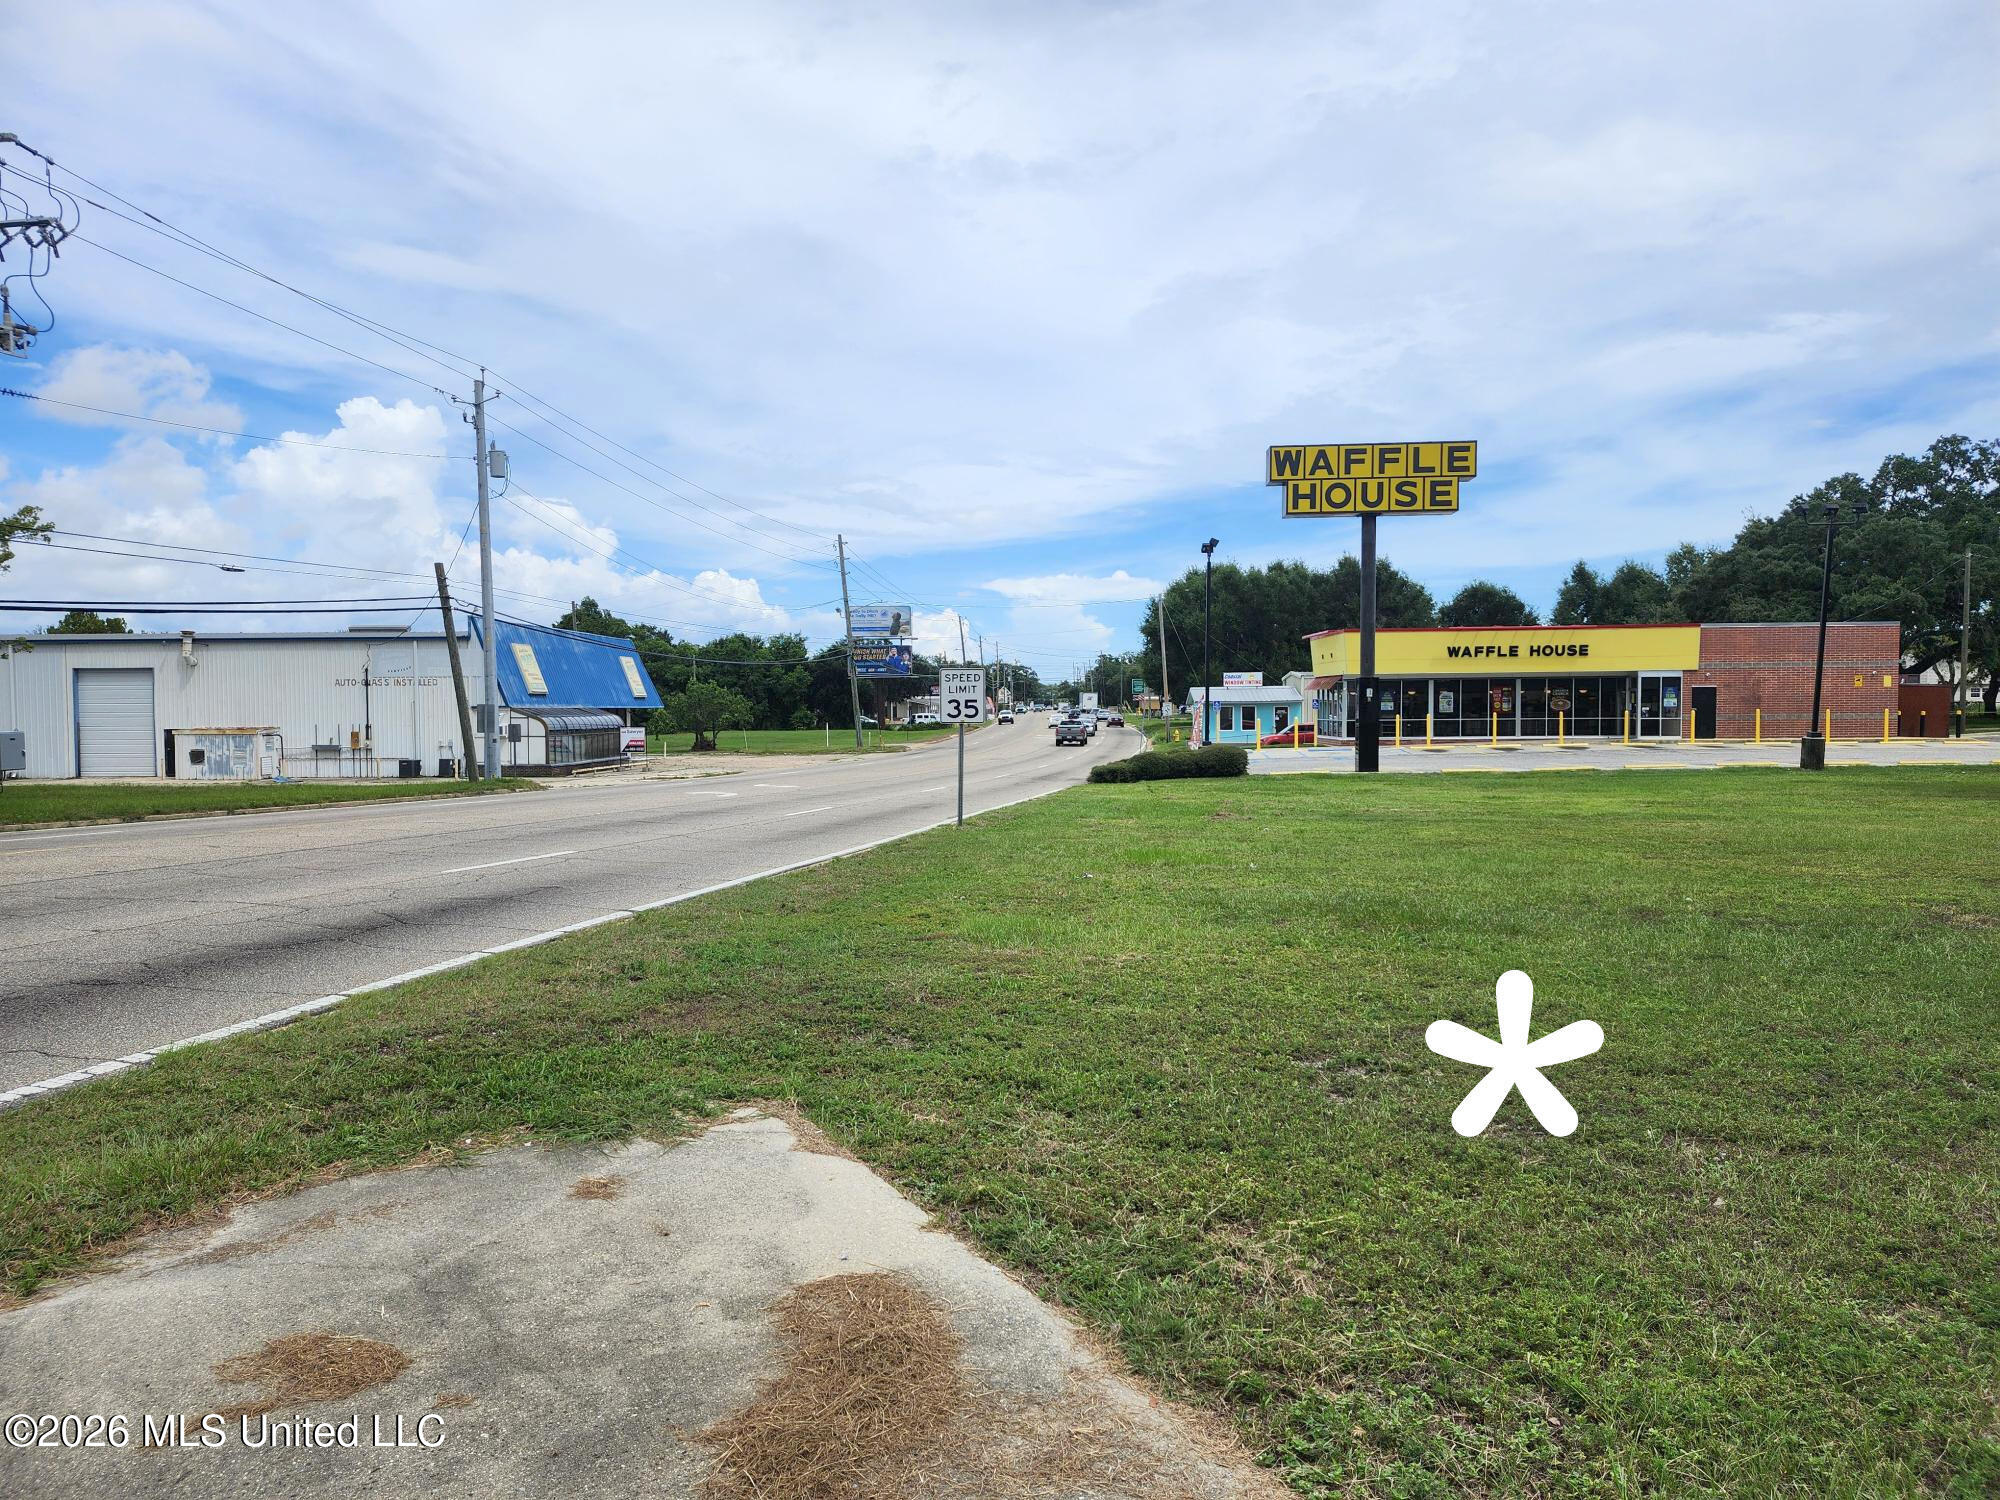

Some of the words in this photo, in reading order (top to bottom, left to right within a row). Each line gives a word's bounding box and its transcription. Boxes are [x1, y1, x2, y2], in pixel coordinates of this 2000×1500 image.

[1273, 445, 1471, 476] WAFFLE
[1292, 479, 1453, 509] HOUSE
[1446, 645, 1519, 657] WAFFLE
[1529, 644, 1589, 657] HOUSE
[944, 673, 981, 682] SPEED
[948, 685, 977, 694] LIMIT
[947, 698, 979, 718] 35
